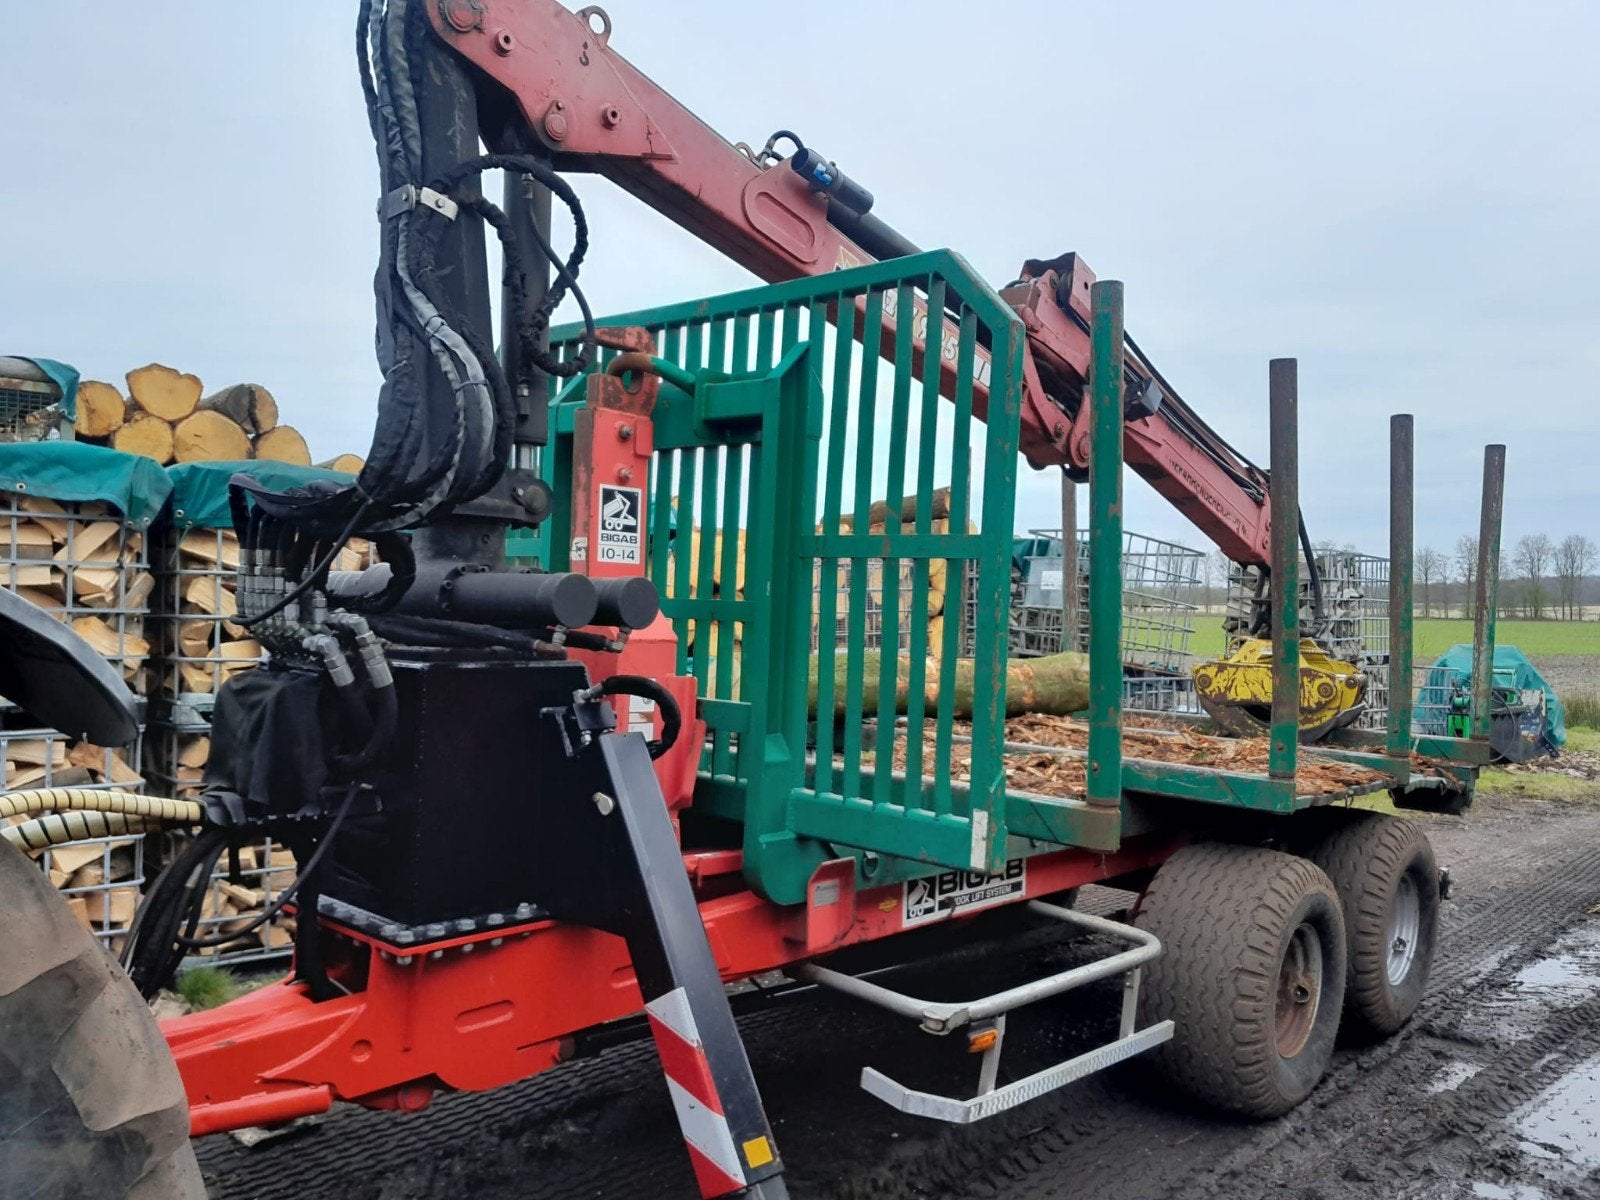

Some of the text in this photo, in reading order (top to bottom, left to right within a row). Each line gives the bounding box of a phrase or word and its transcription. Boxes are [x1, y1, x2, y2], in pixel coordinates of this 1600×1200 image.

[600, 533, 638, 544] BIGAB
[602, 547, 635, 560] 10-14
[971, 890, 985, 902] LIFT
[986, 884, 1012, 898] SYSTEM
